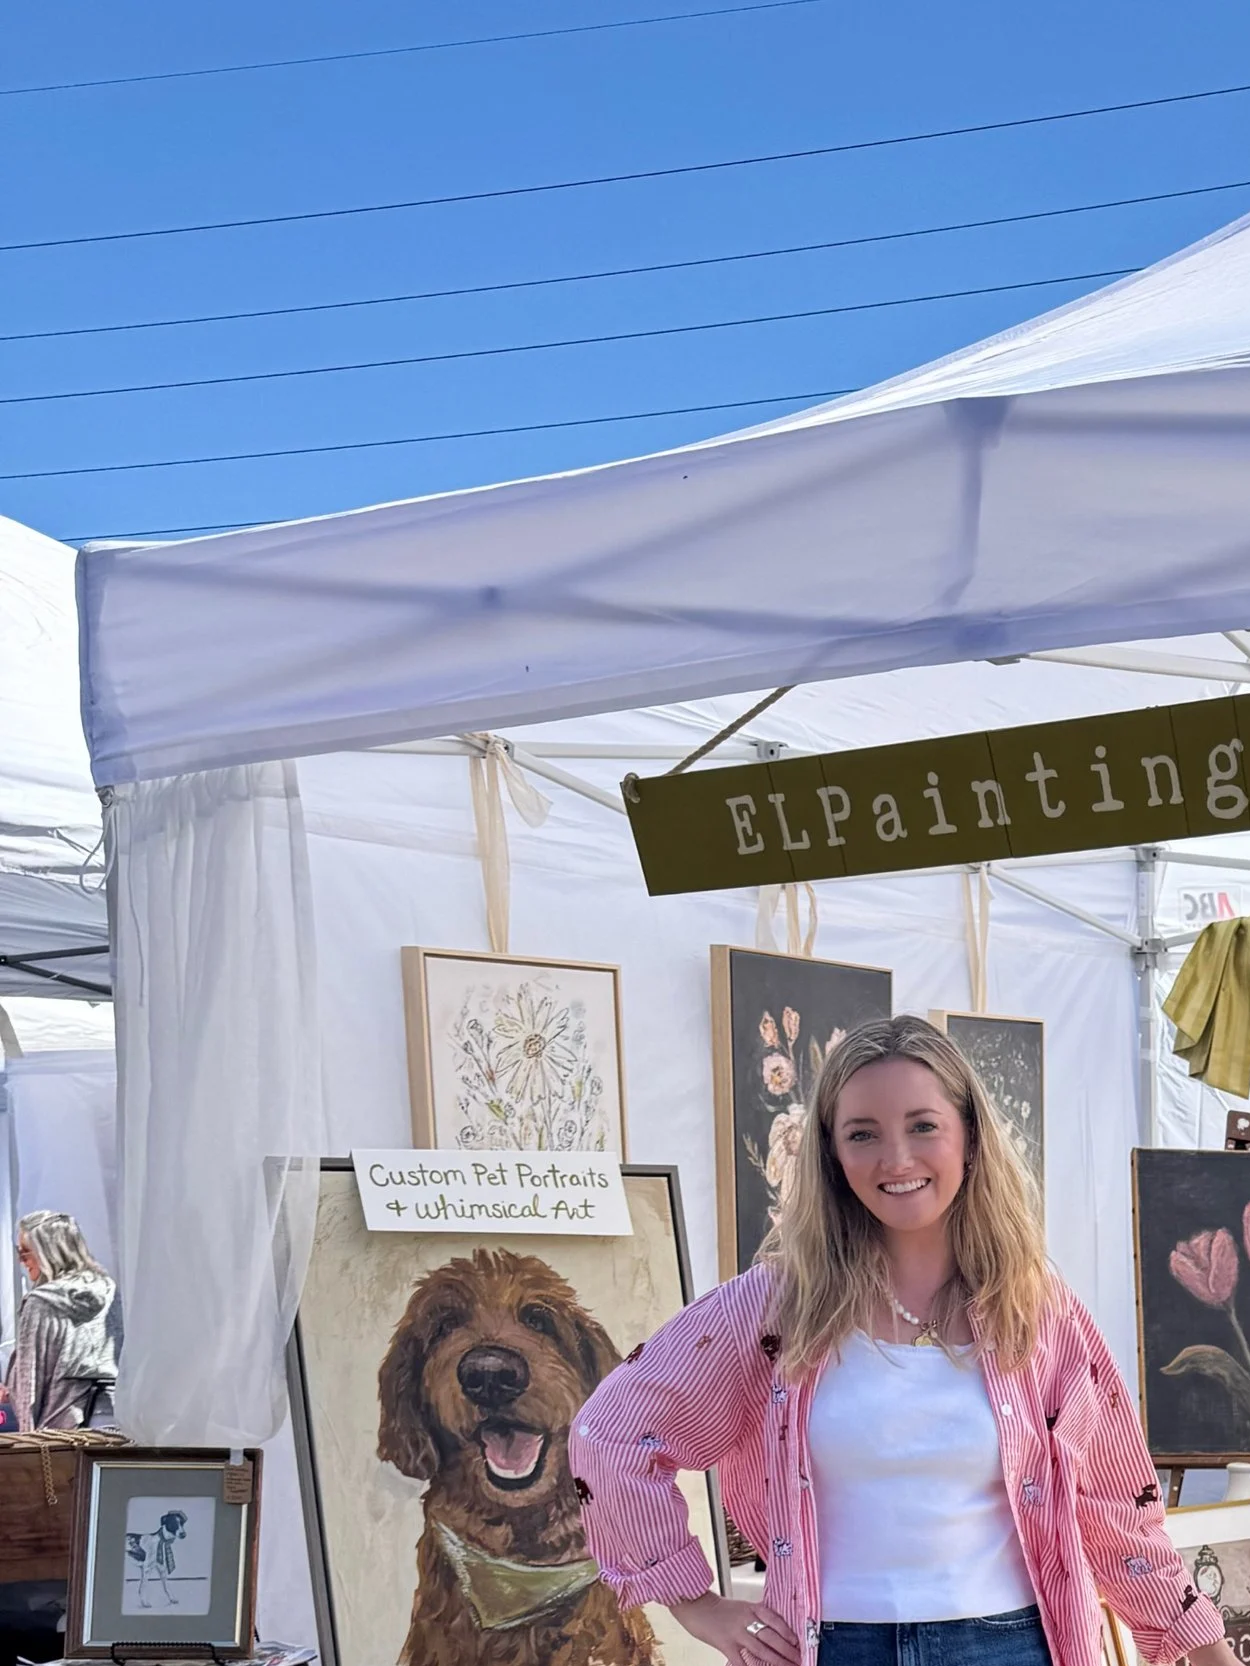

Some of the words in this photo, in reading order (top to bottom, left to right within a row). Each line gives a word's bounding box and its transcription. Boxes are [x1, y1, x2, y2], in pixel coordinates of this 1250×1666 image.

[369, 1163, 466, 1188] Custom
[472, 1162, 508, 1187] Pet
[515, 1162, 609, 1189] Portraits
[551, 1199, 596, 1220] Art
